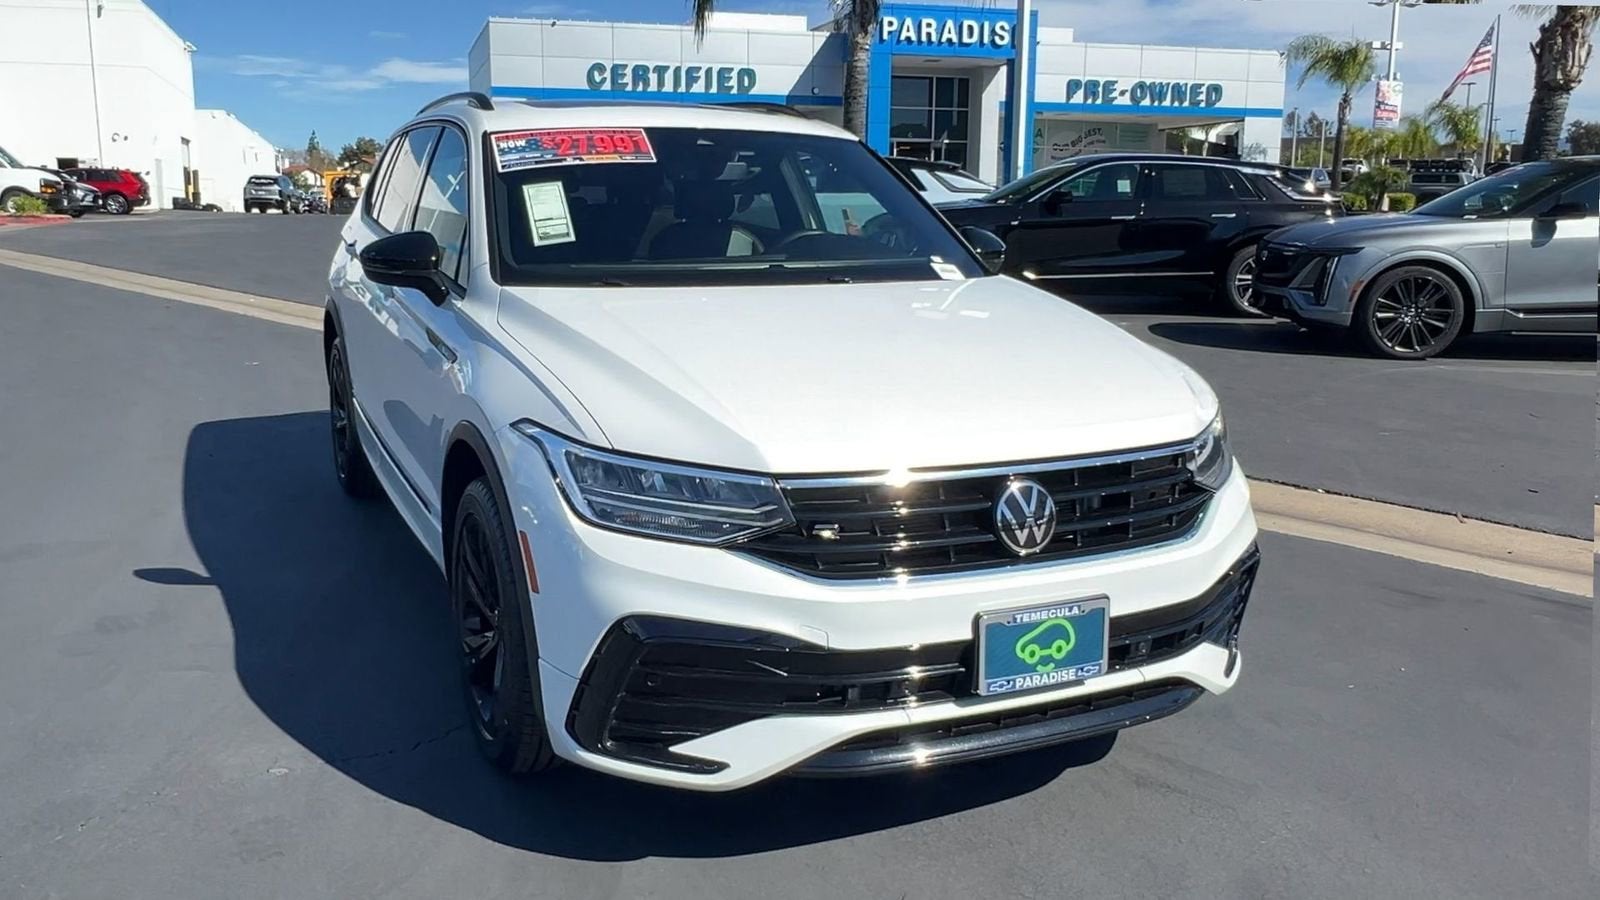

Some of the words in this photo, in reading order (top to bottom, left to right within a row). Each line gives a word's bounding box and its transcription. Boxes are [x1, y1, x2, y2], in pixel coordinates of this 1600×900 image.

[881, 16, 1013, 48] PARADIS
[586, 62, 757, 95] CERTIFIED
[1065, 78, 1223, 108] PRE-OWNED
[499, 138, 528, 149] NOW
[1014, 605, 1080, 623] TEMECULA
[1014, 668, 1077, 689] PARADISE
